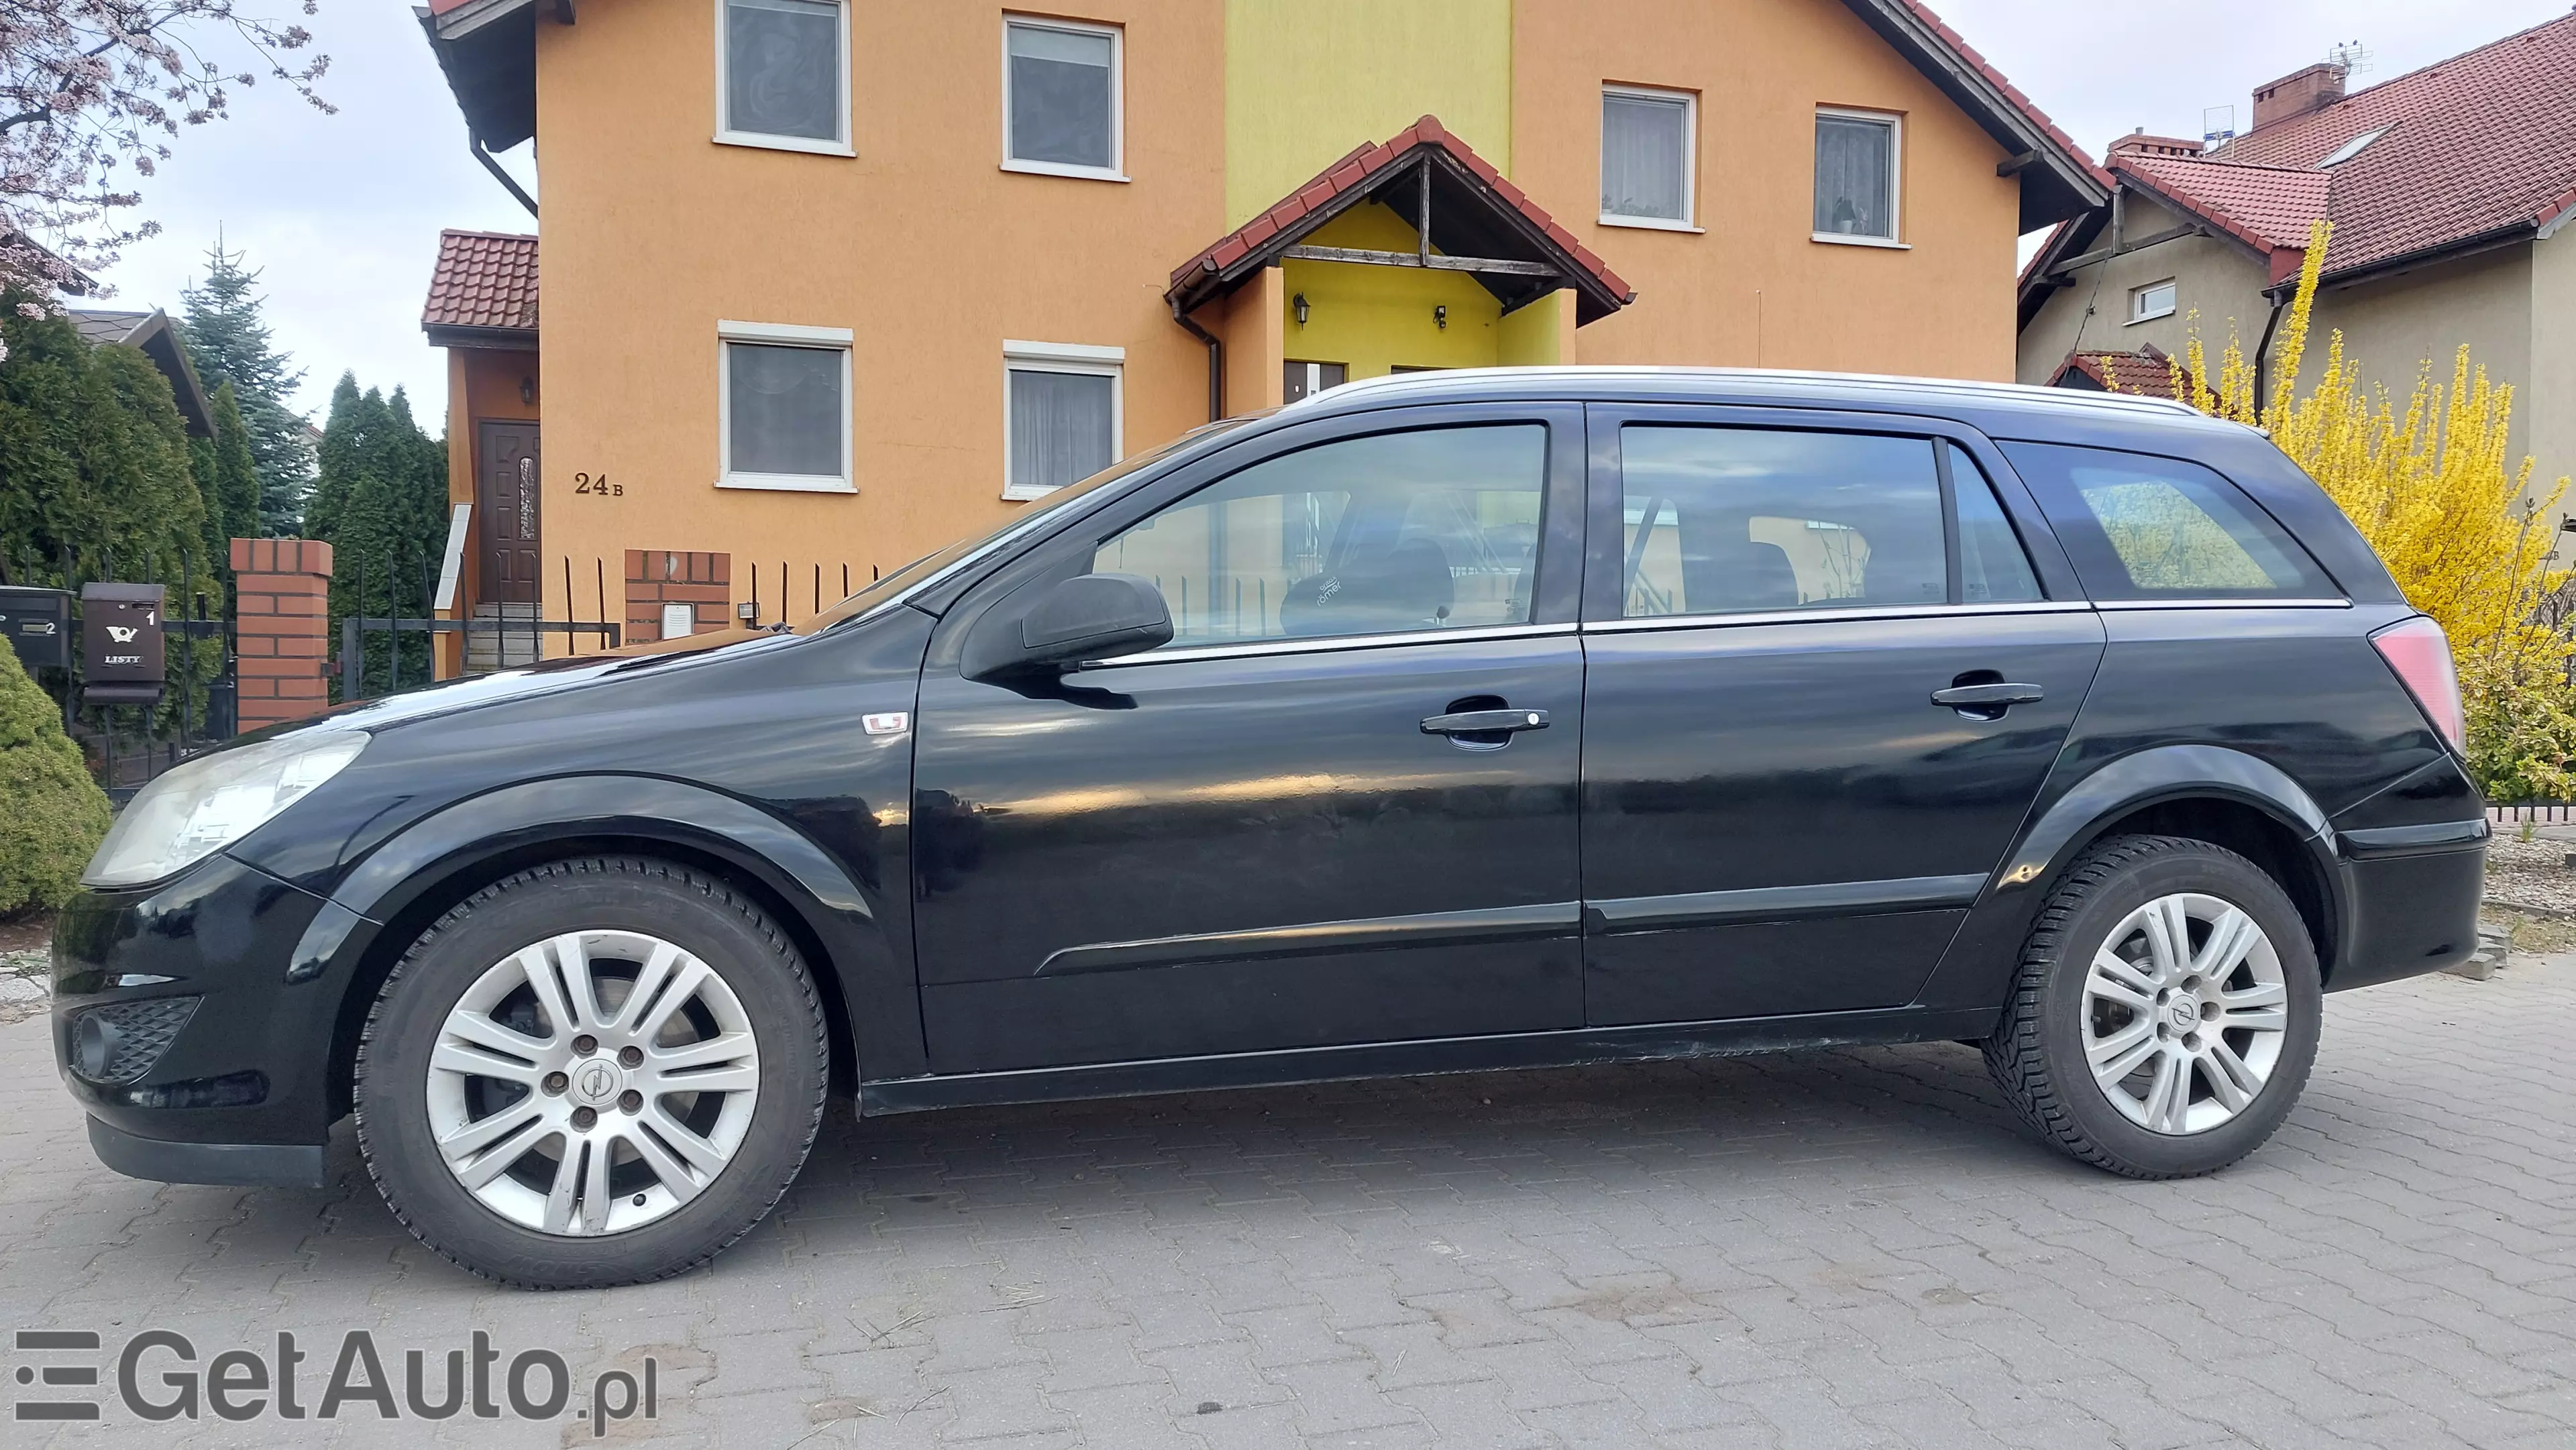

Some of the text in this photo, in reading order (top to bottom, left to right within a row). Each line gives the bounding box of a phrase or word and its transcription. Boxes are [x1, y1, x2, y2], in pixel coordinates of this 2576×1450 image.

[1317, 581, 1342, 607] römer
[146, 611, 154, 626] 1
[45, 622, 56, 634] 2
[104, 655, 142, 664] LISTY
